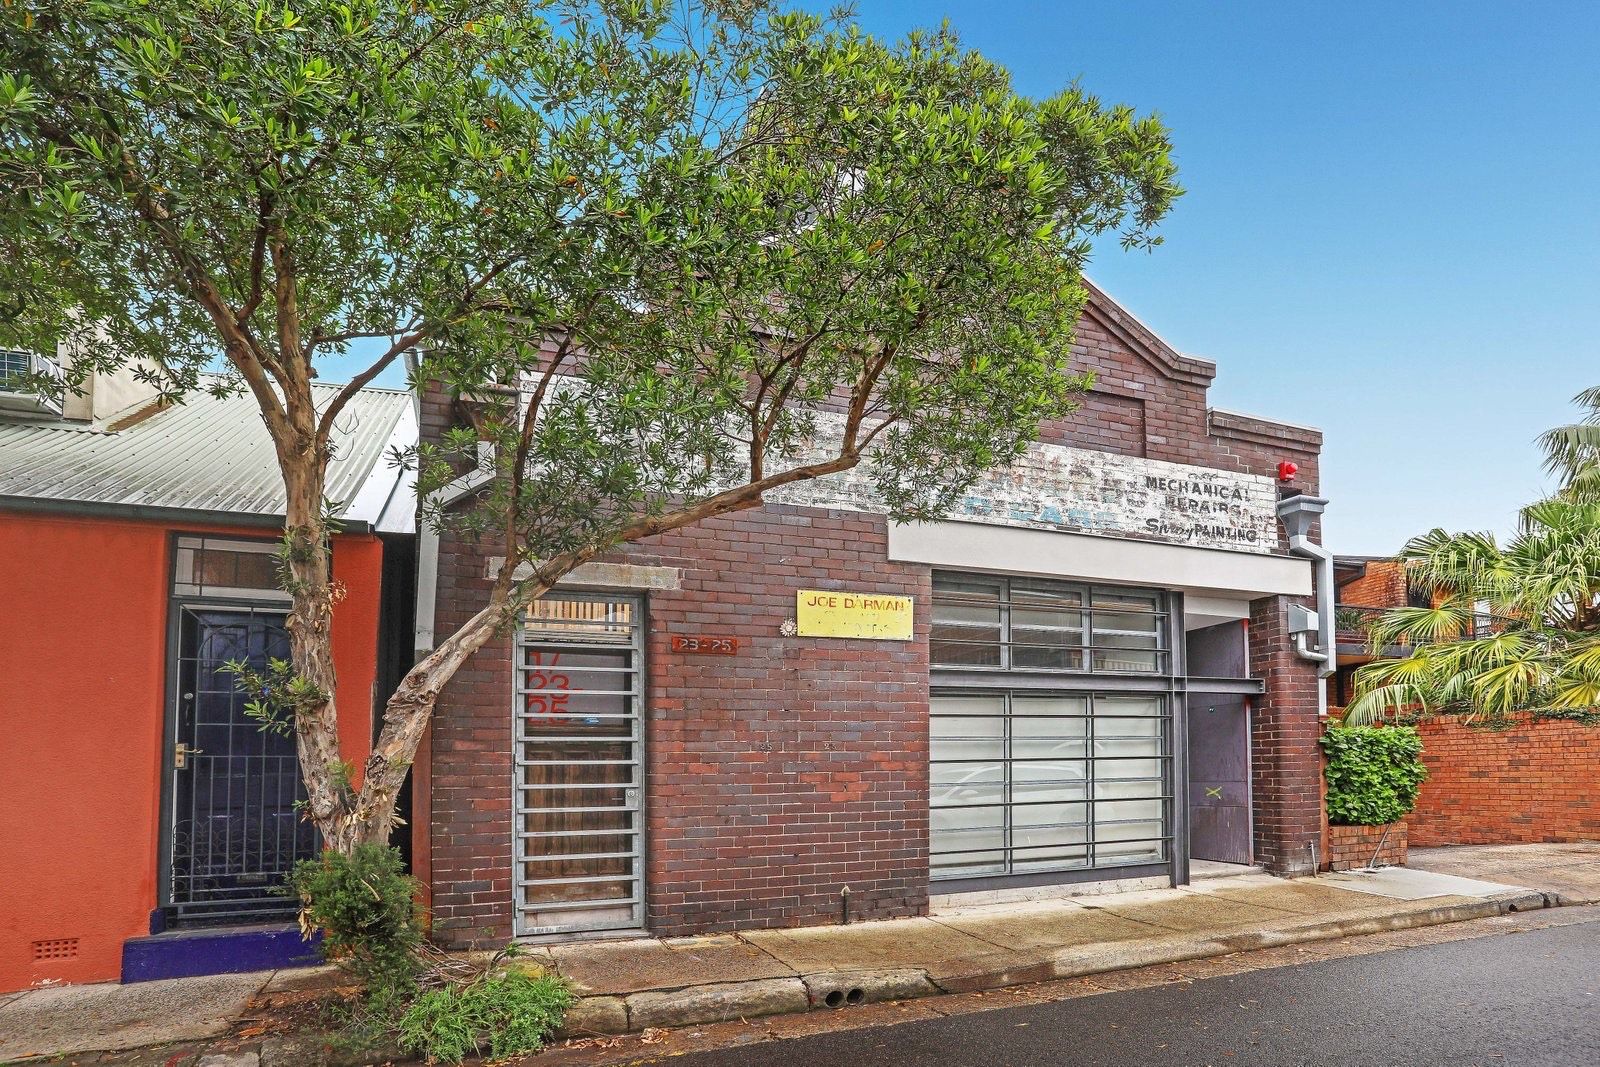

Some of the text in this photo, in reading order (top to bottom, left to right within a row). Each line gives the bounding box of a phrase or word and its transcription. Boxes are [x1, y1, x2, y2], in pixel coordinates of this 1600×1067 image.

[1194, 523, 1257, 542] PAINTING
[807, 596, 904, 612] JOE DARMAN
